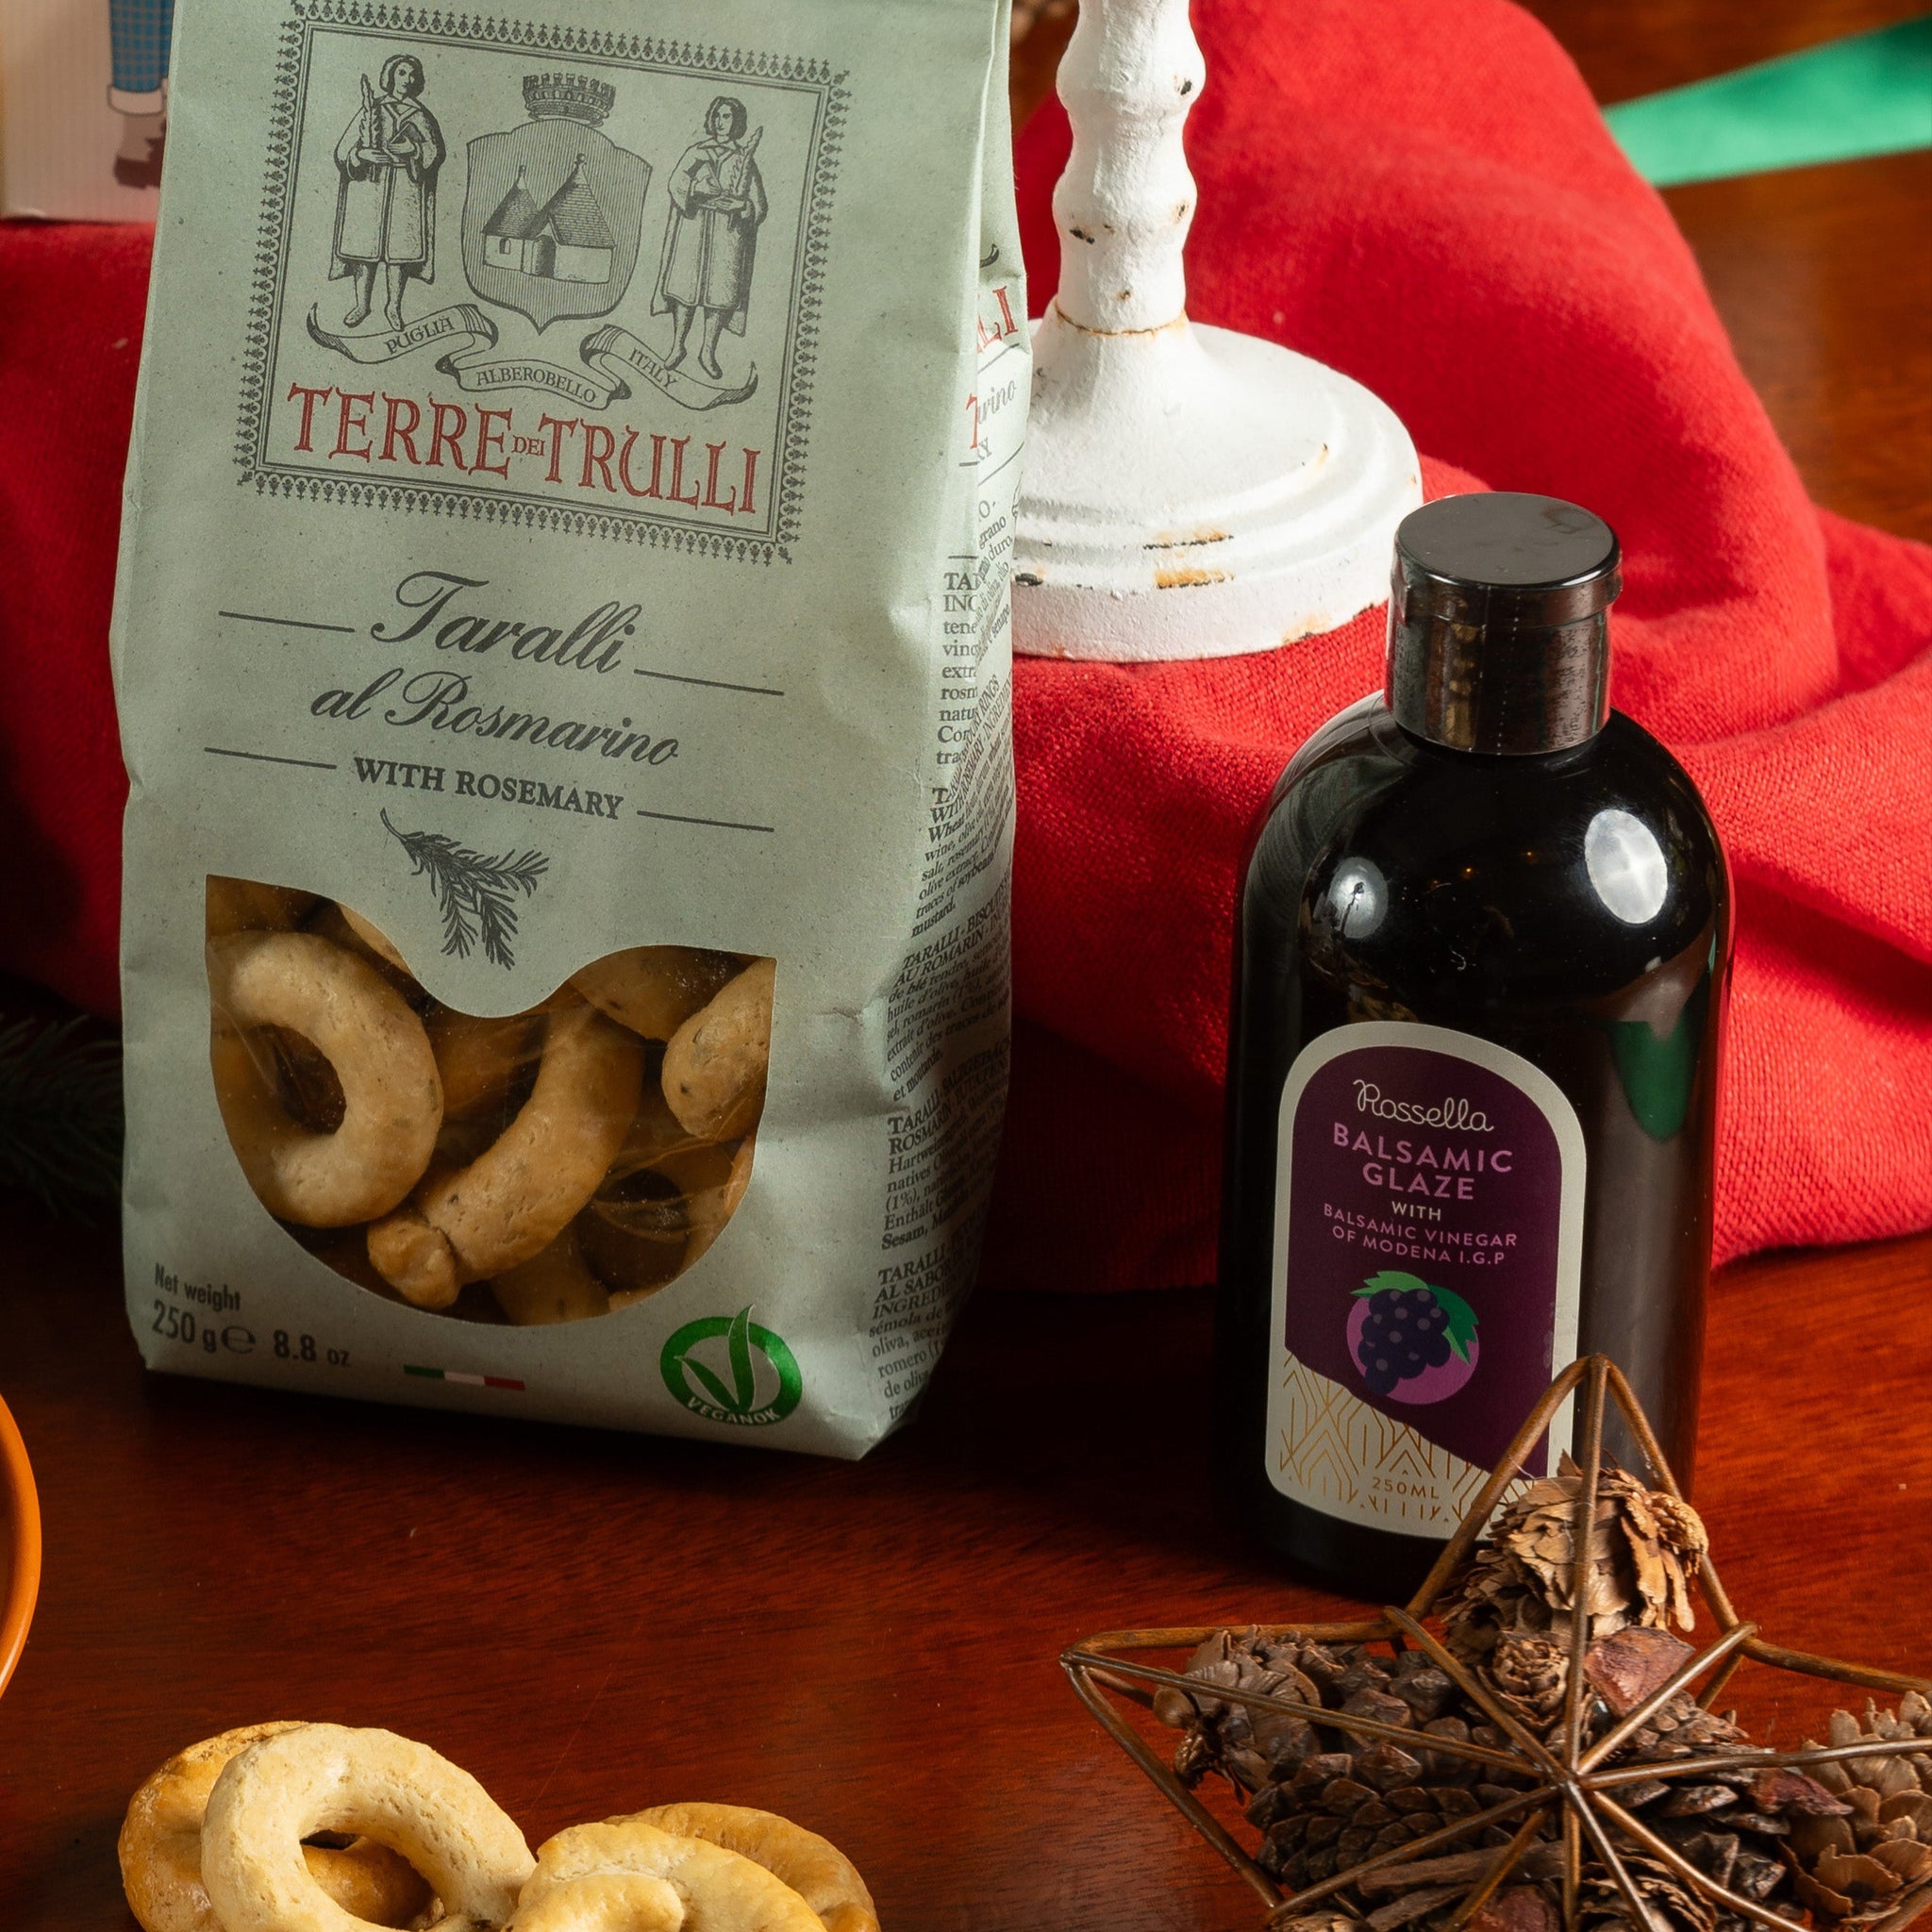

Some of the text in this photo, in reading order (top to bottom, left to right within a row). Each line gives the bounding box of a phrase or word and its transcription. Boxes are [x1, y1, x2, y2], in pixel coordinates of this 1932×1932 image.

[385, 316, 456, 355] PUGLIA
[475, 367, 598, 404] ALBEROBELLO
[629, 346, 678, 390] ITALY
[287, 382, 762, 514] TERRE DEI TRULLI
[370, 570, 643, 675] Taralli
[309, 667, 679, 766] al Rosmarino
[354, 757, 625, 821] WITH ROSEMARY
[919, 876, 944, 900] olive
[893, 966, 921, 989] AU
[922, 926, 985, 974] ROMARIN
[903, 925, 960, 971] TARALLI
[888, 996, 915, 1024] huile
[889, 988, 904, 1004] de
[890, 1042, 924, 1082] contenir
[887, 1088, 941, 1135] TARALLI
[893, 1085, 907, 1102] et
[1353, 1079, 1494, 1132] Rossella
[1333, 1122, 1513, 1174] BALSAMIC
[887, 1169, 931, 1193] natives
[1362, 1162, 1475, 1200] GLAZE
[1324, 1203, 1517, 1246] BALSAMIC VINEGAR
[1391, 1200, 1441, 1222] WITH
[881, 1223, 928, 1252] Sesam,
[1332, 1225, 1505, 1265] OF MODENA I.G.P
[155, 1262, 241, 1312] Net weight
[874, 1284, 900, 1304] AL
[152, 1298, 196, 1343] 250
[274, 1329, 317, 1362] 8.8
[326, 1348, 352, 1367] oz
[873, 1334, 909, 1358] oliva,
[877, 1348, 927, 1380] romero
[884, 1380, 901, 1399] de
[688, 1396, 780, 1424] VEGANOK
[1373, 1476, 1440, 1499] 250ML
